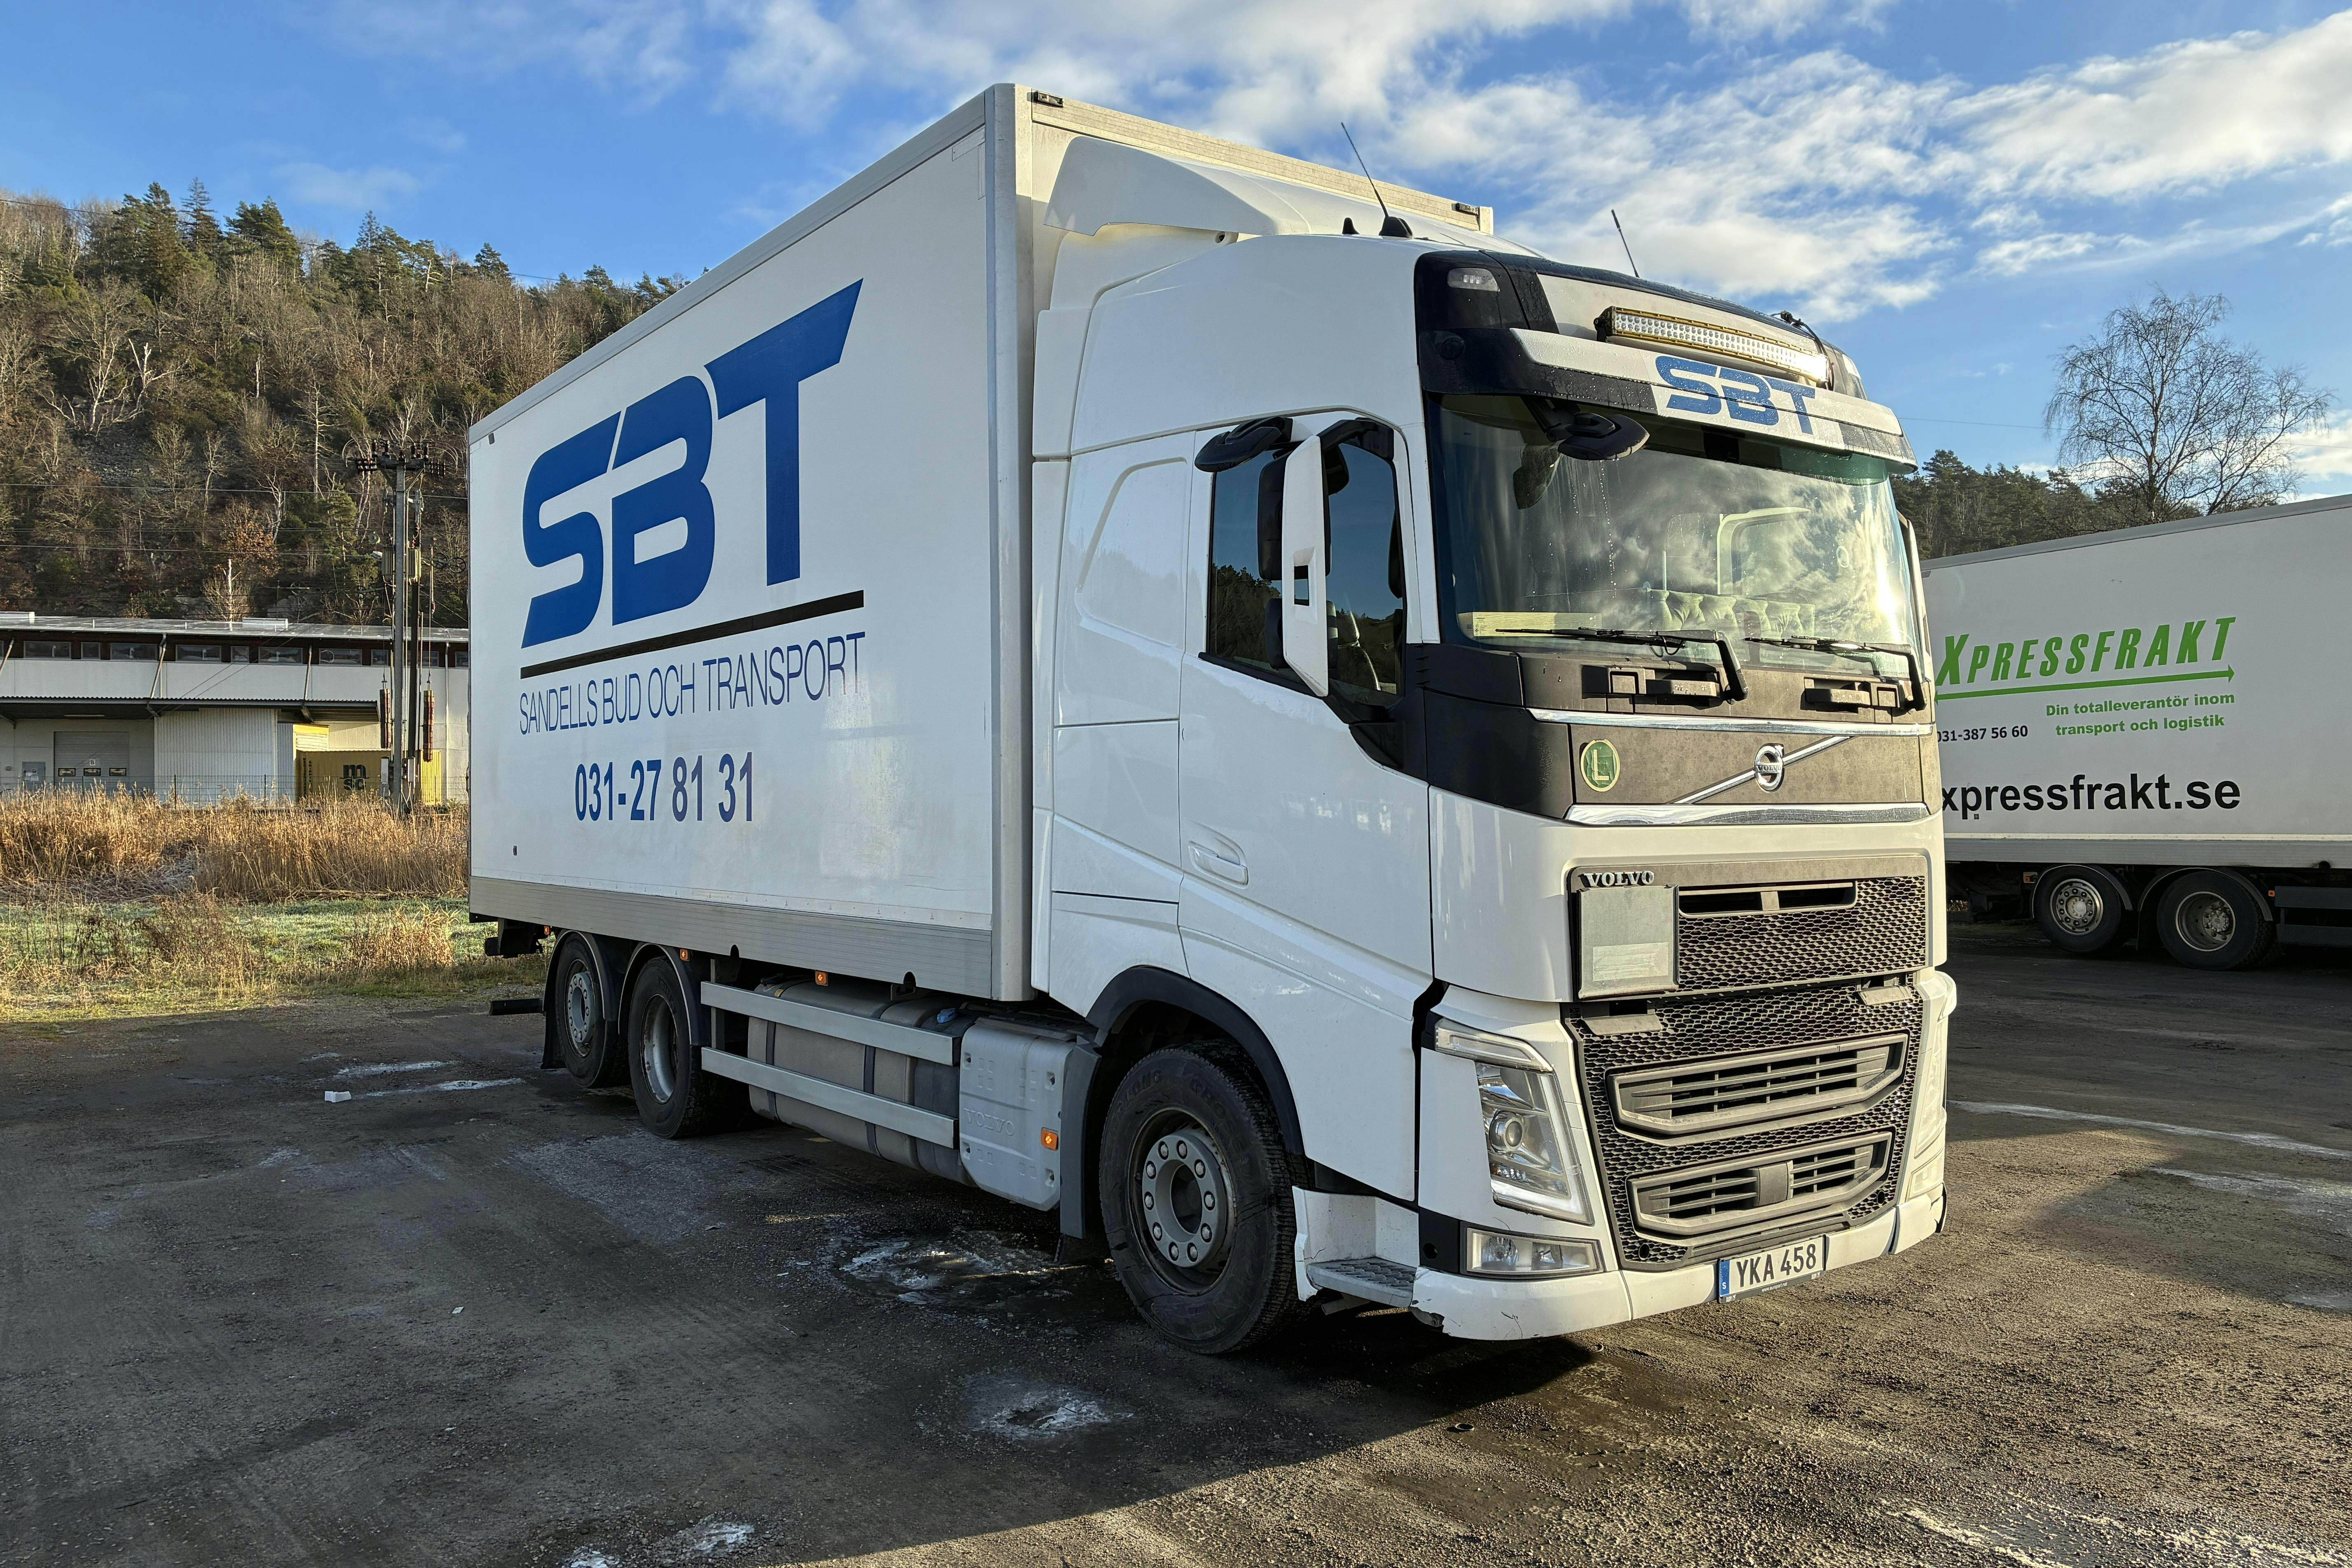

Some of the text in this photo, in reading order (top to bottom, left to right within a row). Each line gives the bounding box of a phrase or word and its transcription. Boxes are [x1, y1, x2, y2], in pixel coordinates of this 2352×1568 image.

[1655, 356, 1815, 435] SBT
[521, 278, 863, 649] SBT
[1935, 617, 2236, 686] XPRESSFRAKT
[520, 631, 865, 735] SANDELLS BUD OCH TRANSPORT
[2046, 694, 2235, 716] Din totalleverantör inom
[1991, 727, 2007, 739] 56
[2012, 725, 2028, 737] 60
[2056, 714, 2225, 736] transport och logistik
[1593, 749, 1609, 780] L
[575, 752, 752, 822] 031-27 81 31
[1583, 870, 1654, 887] VOLVO
[963, 1108, 1014, 1136] VOLVO
[1736, 1244, 1816, 1288] YKA 458
